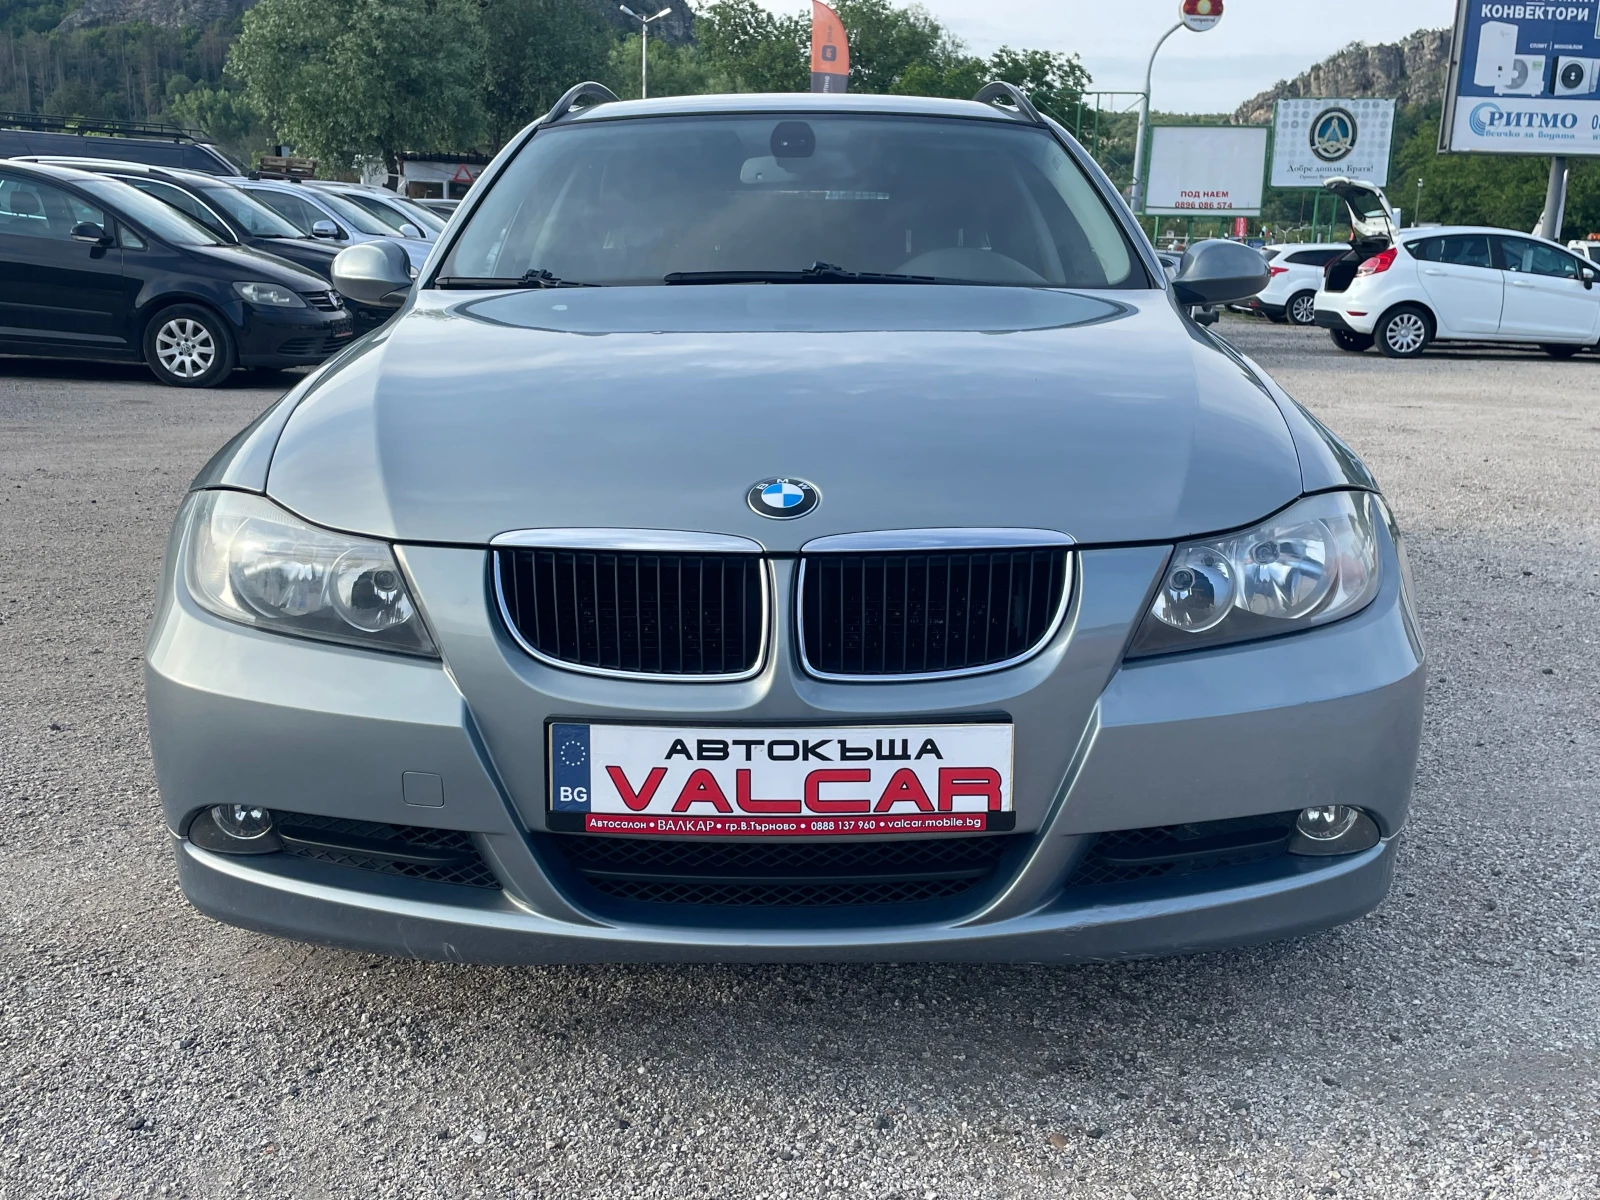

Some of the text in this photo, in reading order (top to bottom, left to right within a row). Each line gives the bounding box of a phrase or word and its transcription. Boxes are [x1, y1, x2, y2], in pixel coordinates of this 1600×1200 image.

[1481, 4, 1589, 21] КОНВЕКТОРИ
[1487, 111, 1578, 129] РИТМО
[1286, 165, 1313, 173] Добре
[1346, 165, 1374, 173] Братя!
[1175, 201, 1196, 209] 0896
[756, 478, 811, 490] BMW
[665, 738, 944, 762] АВТОКЪЩА
[560, 787, 588, 802] BG
[605, 765, 1004, 813] VALCAR
[589, 818, 797, 832] Автосалон ВАЛКАР гр.В.Търново
[811, 817, 982, 831] 0888 137 960 valcar.mobile.bg
